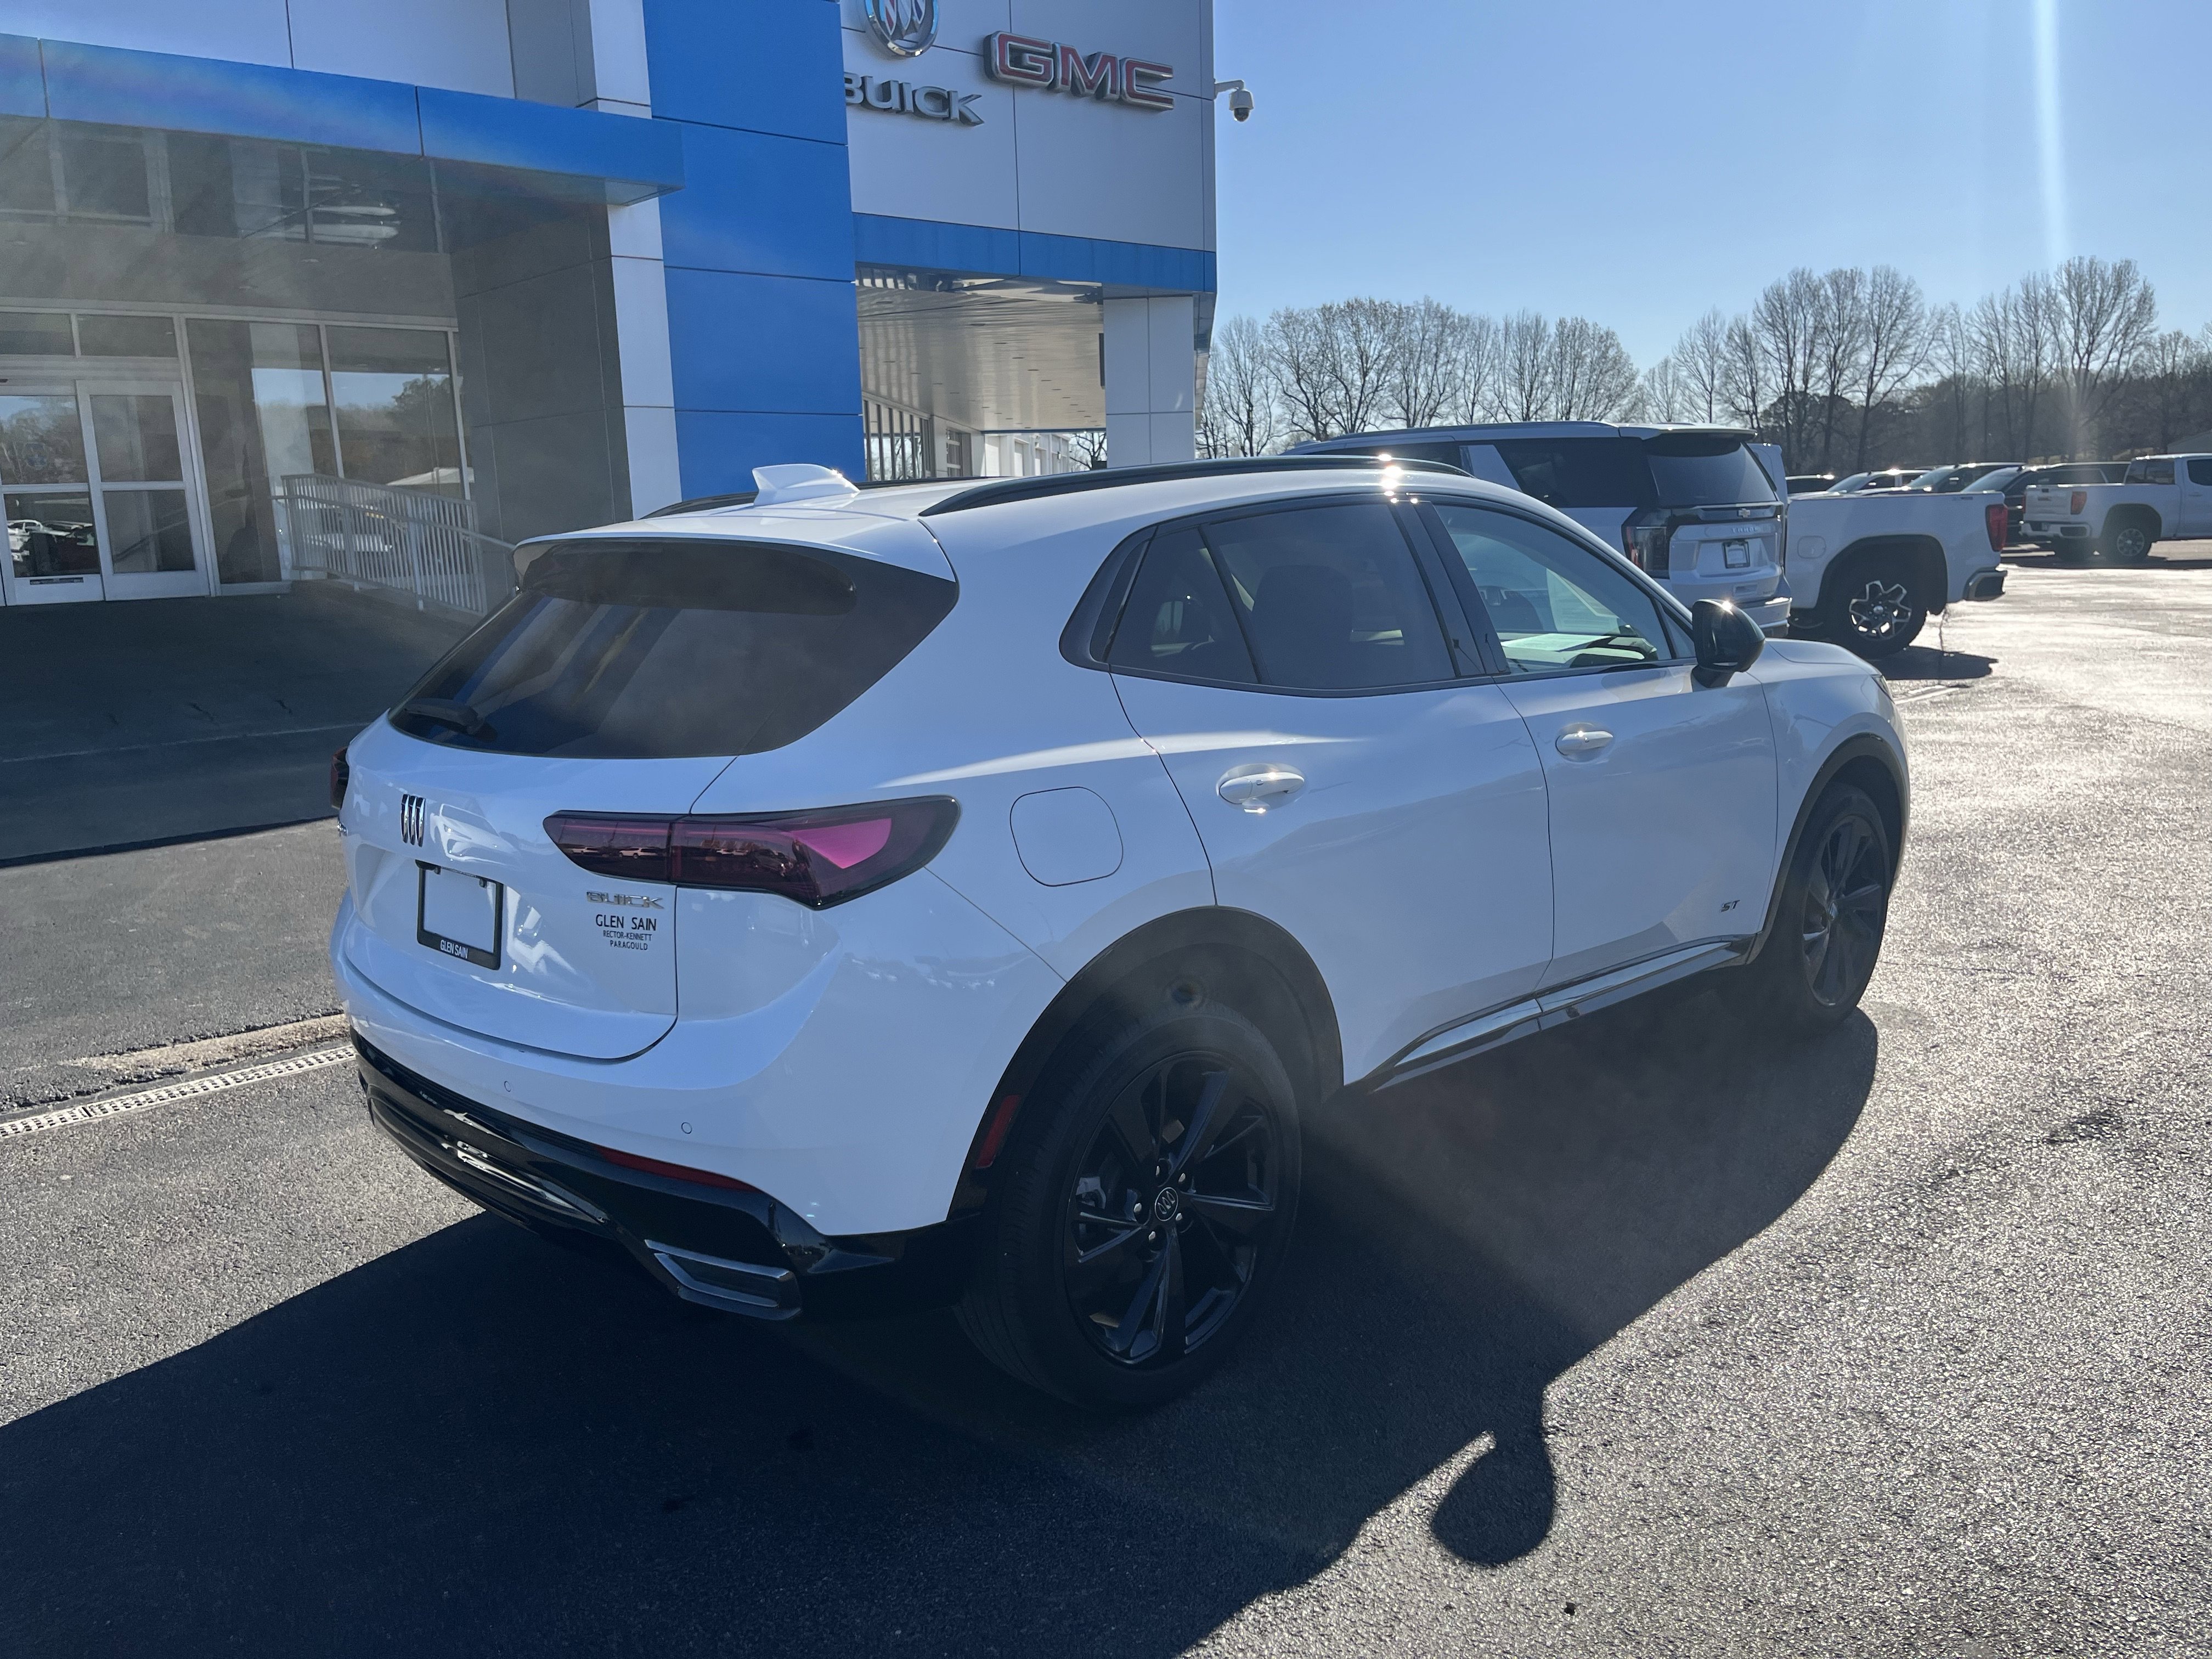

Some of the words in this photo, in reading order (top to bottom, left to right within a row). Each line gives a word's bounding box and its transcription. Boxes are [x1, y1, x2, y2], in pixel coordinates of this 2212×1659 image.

[984, 30, 1175, 111] GMC
[844, 72, 984, 126] BUICK
[586, 891, 664, 909] BUICK
[1720, 900, 1740, 912] ST
[596, 914, 624, 929] GLEN
[631, 917, 657, 931] SAIN
[603, 930, 652, 941] RECTOR-KENNETT
[440, 940, 455, 954] GLEN
[455, 945, 468, 960] SAIN
[610, 940, 648, 951] PARAGOULD
